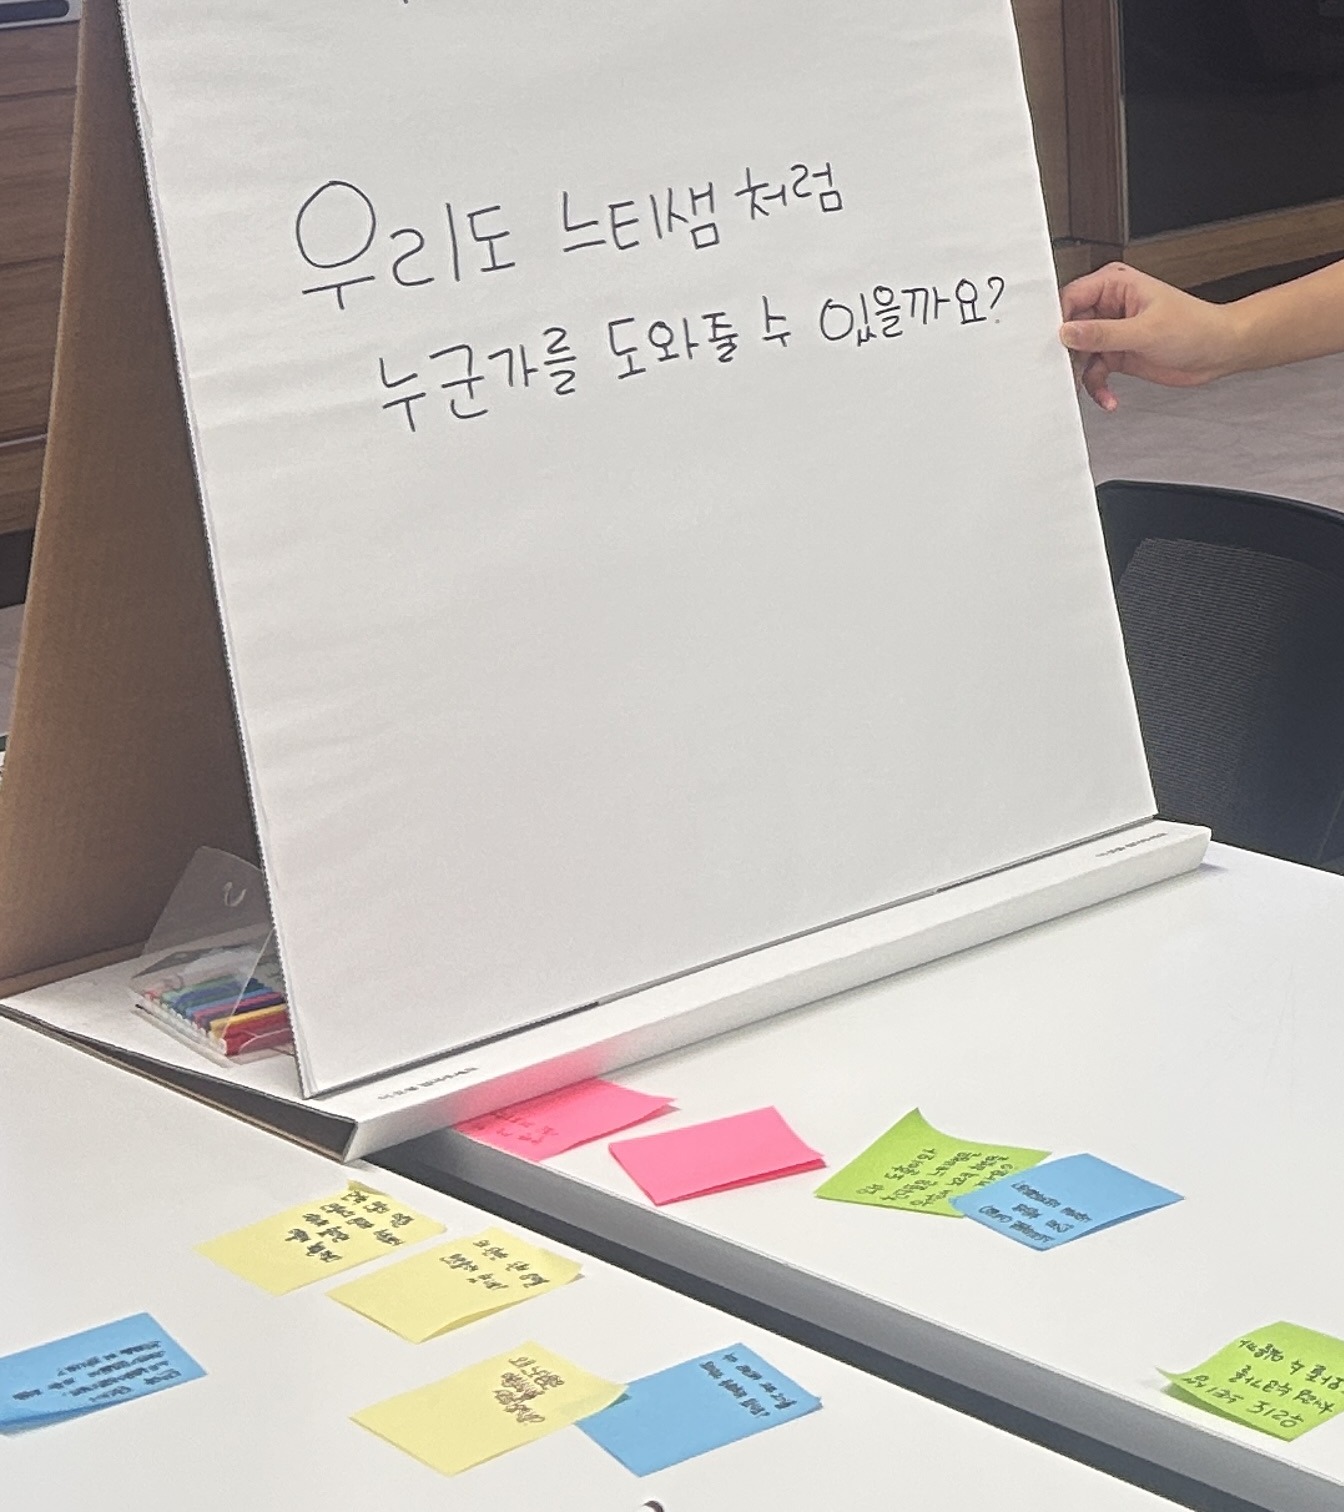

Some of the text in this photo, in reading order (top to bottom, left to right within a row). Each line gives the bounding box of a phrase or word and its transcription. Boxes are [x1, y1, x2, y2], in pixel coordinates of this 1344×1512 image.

[295, 180, 517, 311] 우리도
[379, 325, 578, 434] 누군가를
[761, 294, 793, 348] 수
[818, 274, 1006, 349] 있을까요?
